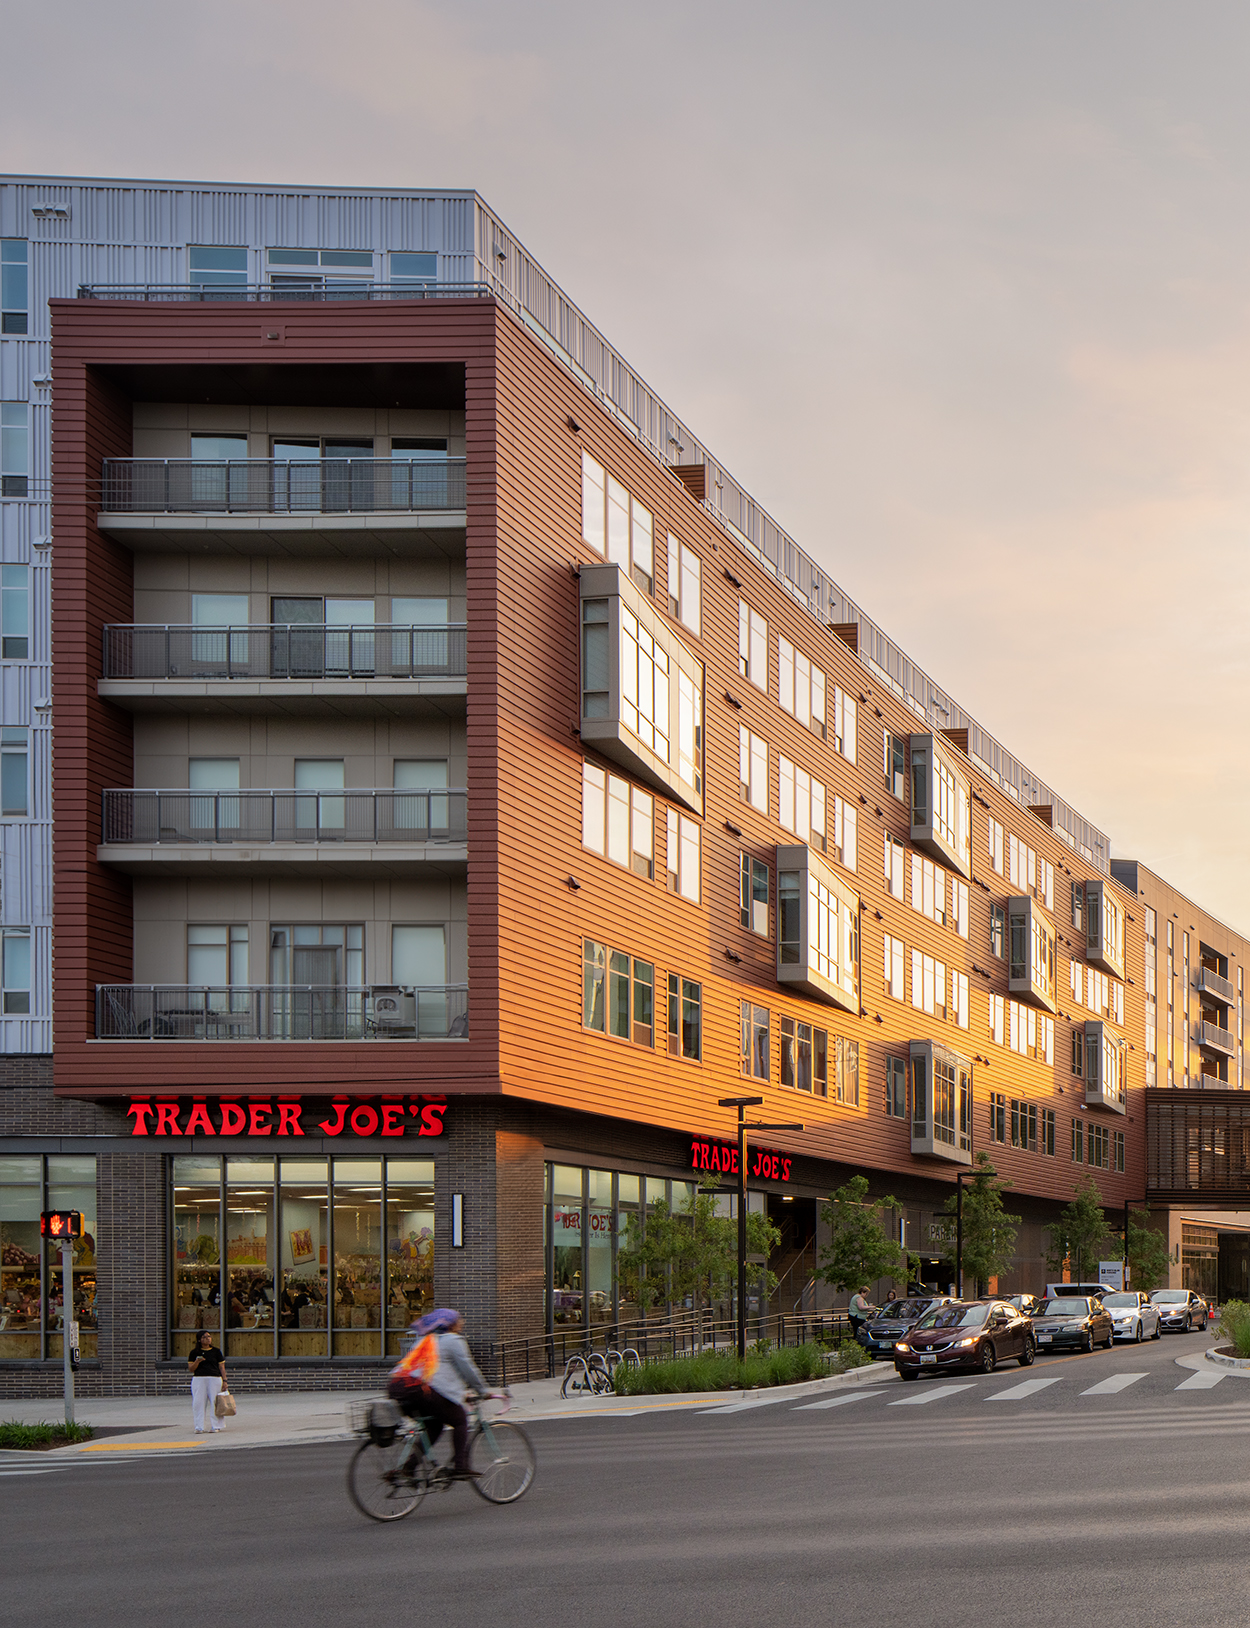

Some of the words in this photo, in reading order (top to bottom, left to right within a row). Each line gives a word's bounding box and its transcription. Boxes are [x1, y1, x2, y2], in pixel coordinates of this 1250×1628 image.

[126, 1103, 306, 1136] TRADER
[317, 1103, 448, 1137] JOE'S
[691, 1141, 749, 1175] TRADE
[752, 1152, 792, 1181] JOE'S
